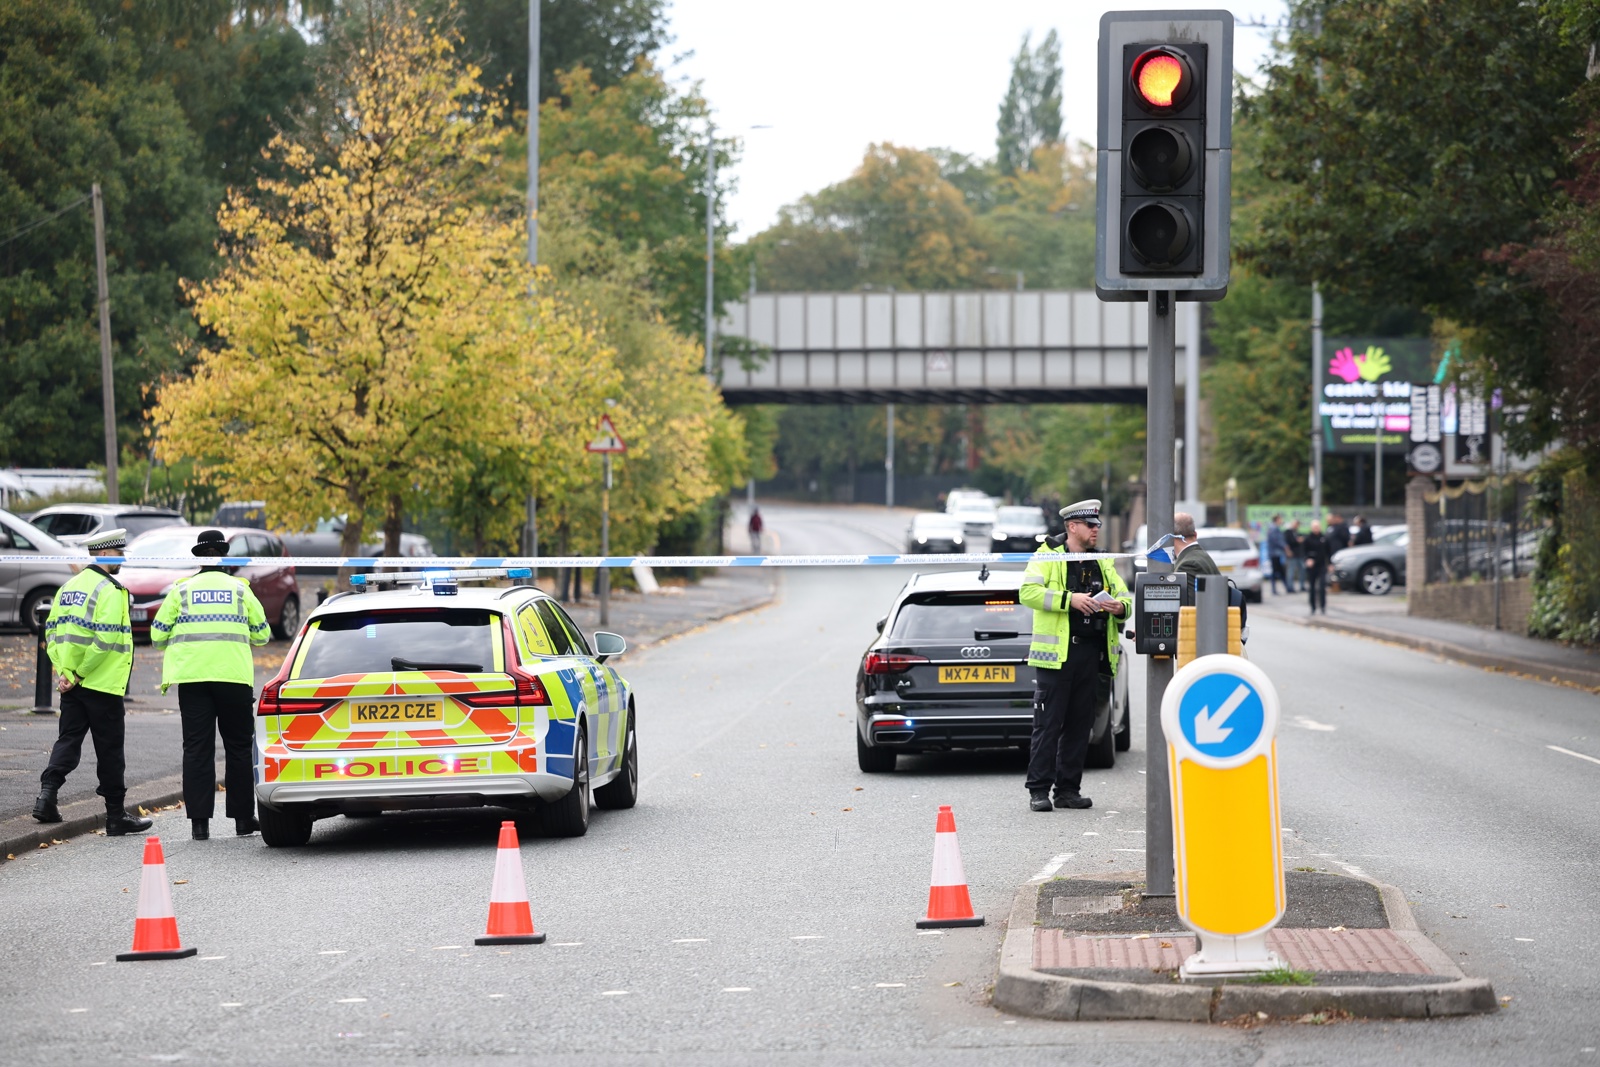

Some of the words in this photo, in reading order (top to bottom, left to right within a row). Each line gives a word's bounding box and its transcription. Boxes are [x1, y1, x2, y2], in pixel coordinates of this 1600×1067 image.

[61, 592, 86, 605] POLCE
[193, 591, 231, 603] POLICE
[945, 668, 980, 680] MX74
[984, 667, 1010, 680] AFN
[357, 704, 400, 721] KR22
[404, 703, 436, 719] CZE
[314, 757, 480, 779] POLICE
